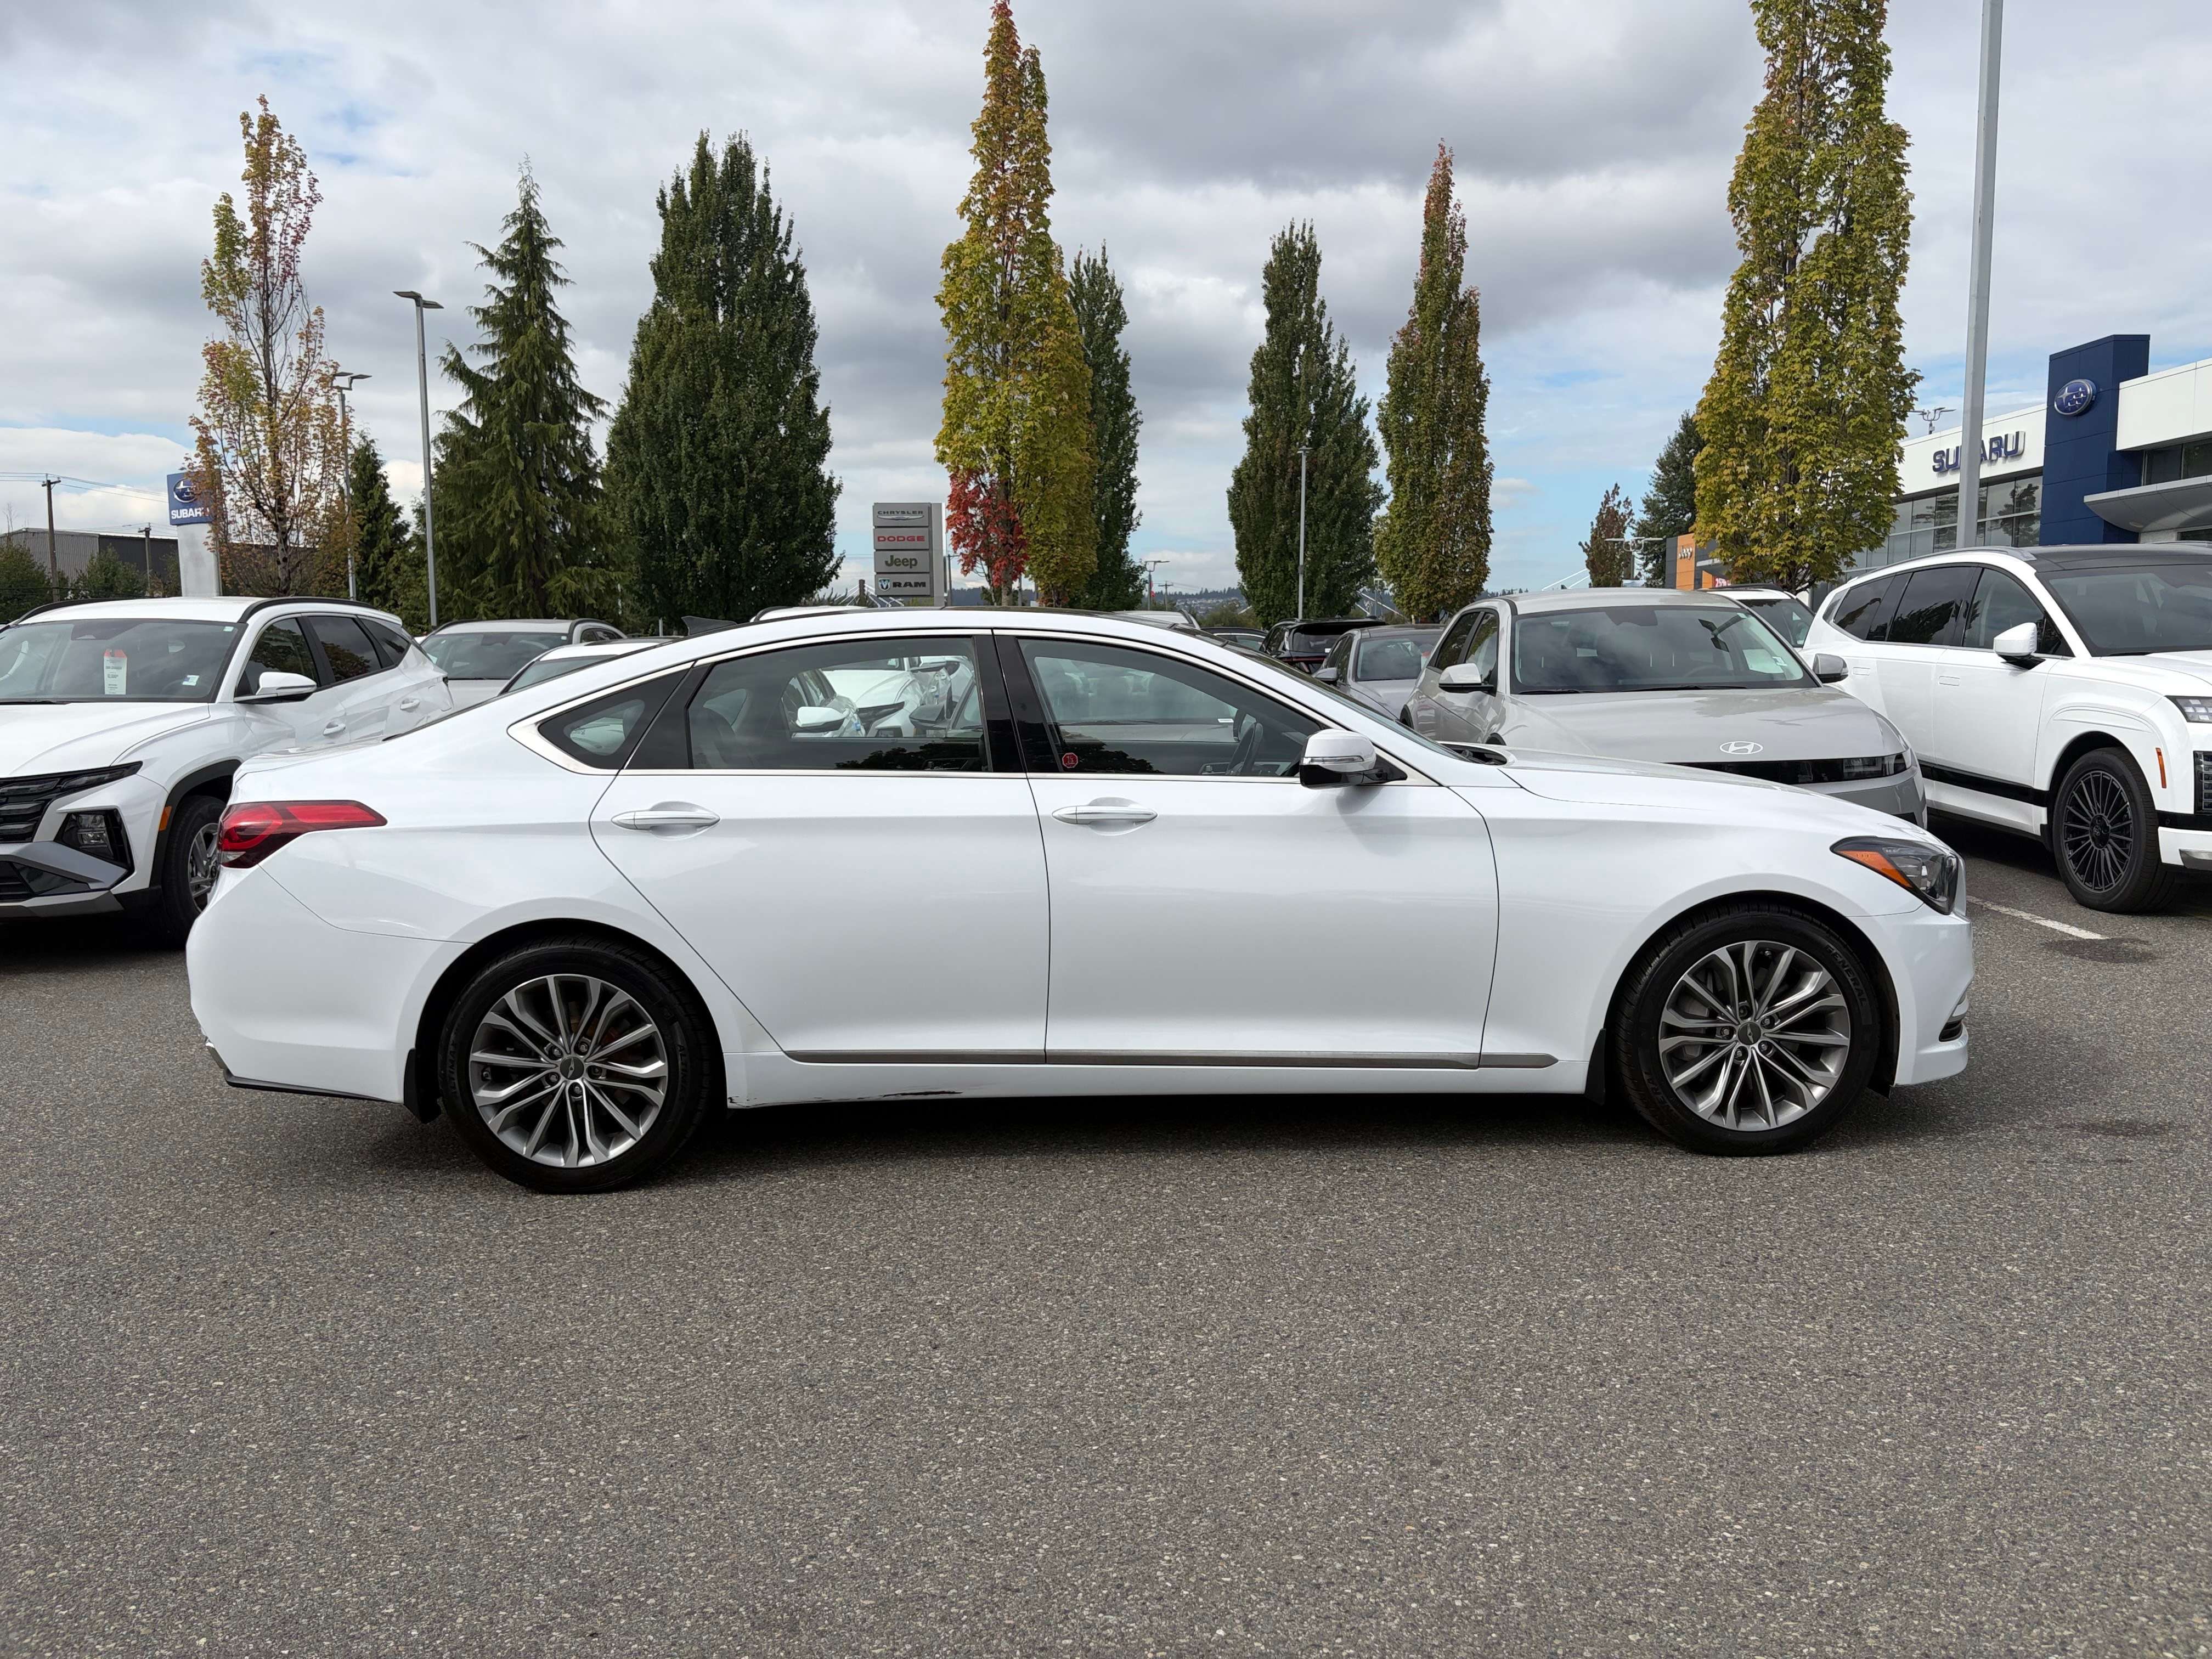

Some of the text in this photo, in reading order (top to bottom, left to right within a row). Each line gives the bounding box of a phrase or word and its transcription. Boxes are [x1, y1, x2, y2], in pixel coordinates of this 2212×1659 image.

[1933, 431, 2025, 472] SUARU
[885, 555, 918, 569] Jeep
[1825, 944, 1866, 1007] GENERAL
